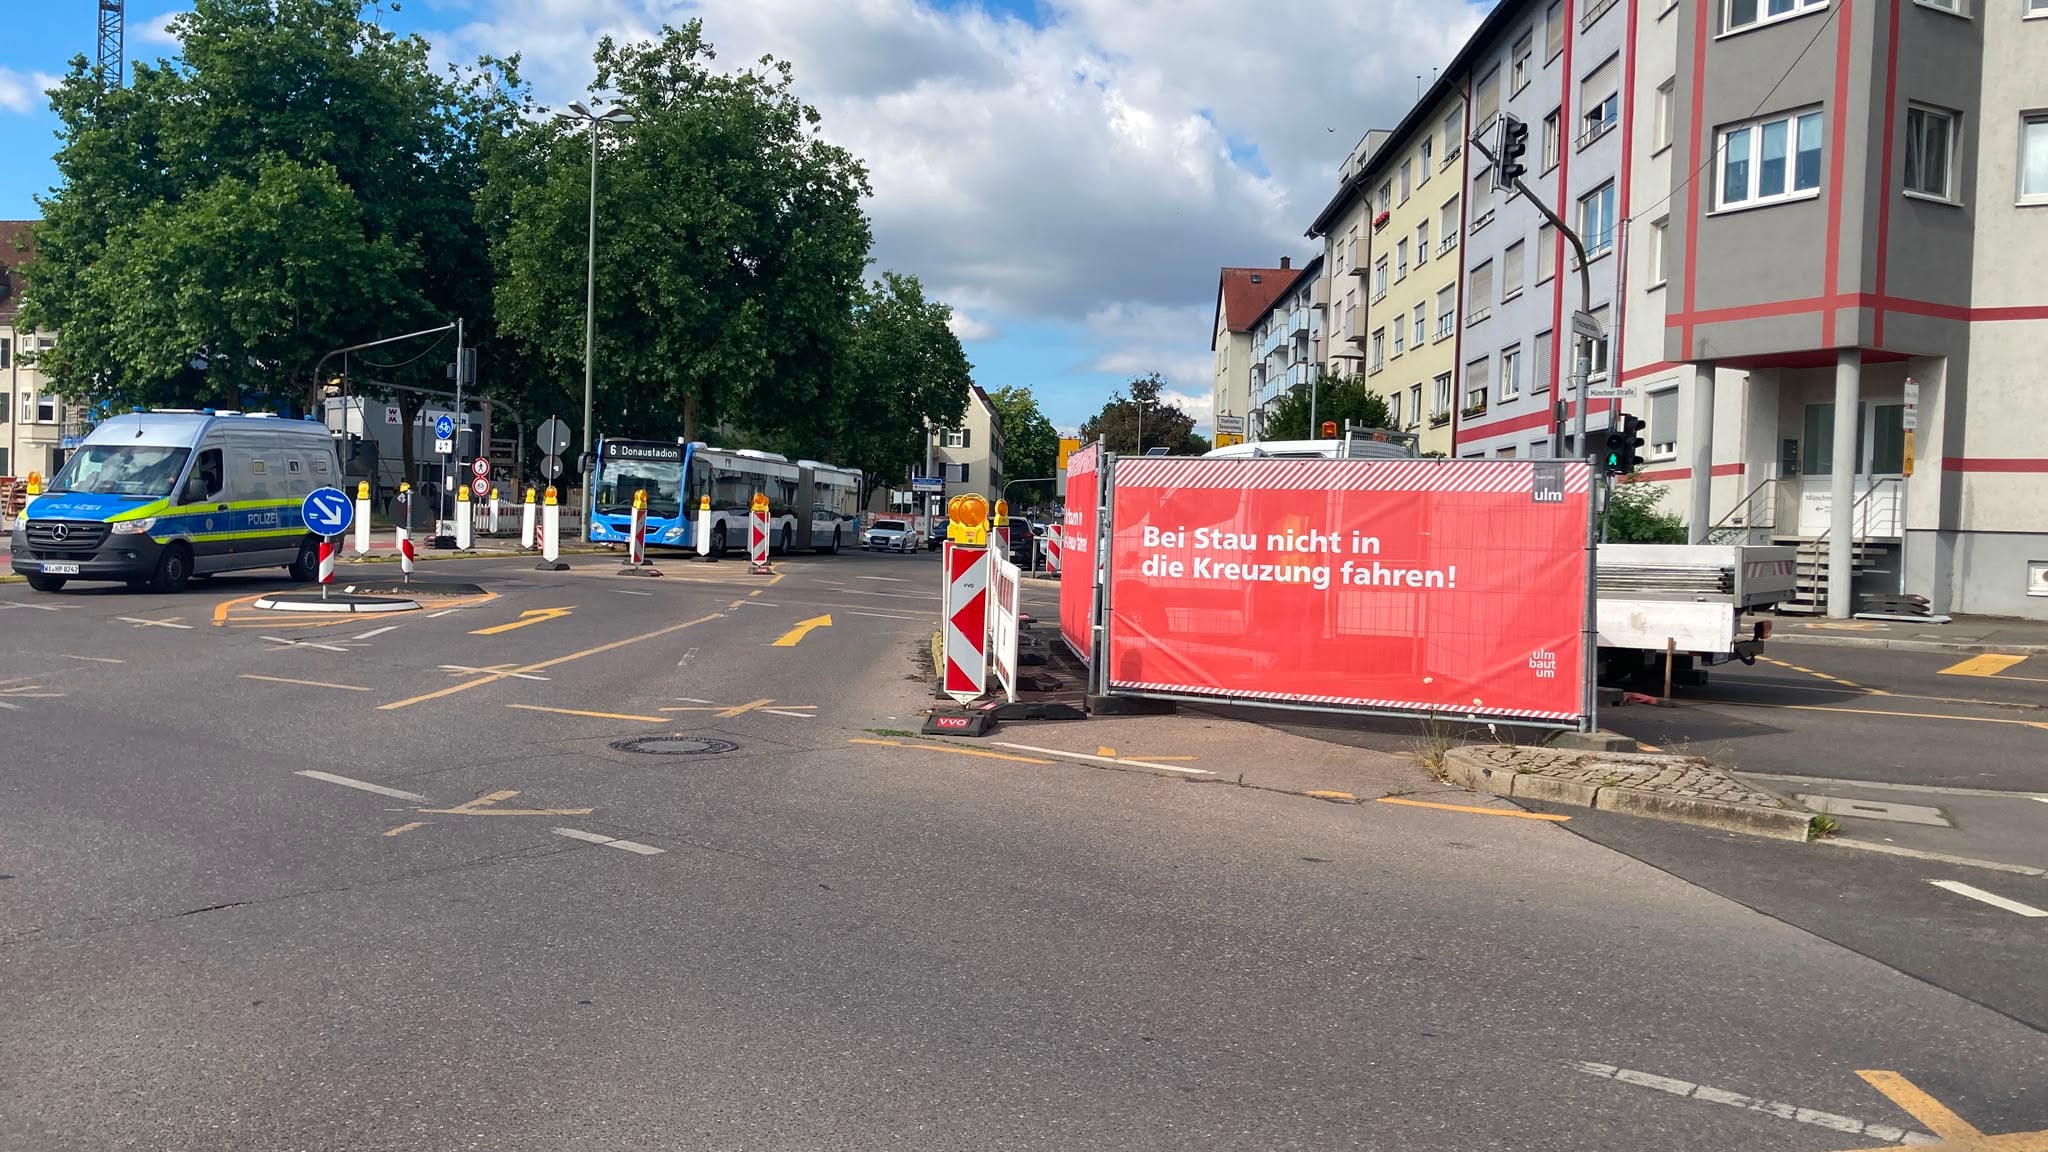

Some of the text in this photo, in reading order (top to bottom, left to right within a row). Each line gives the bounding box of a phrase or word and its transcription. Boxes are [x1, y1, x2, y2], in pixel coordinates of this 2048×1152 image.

[1617, 387, 1634, 396] Straße
[610, 445, 678, 458] 6 Donaustadion
[1534, 488, 1562, 501] ulm
[46, 503, 102, 511] POLIZEI
[247, 512, 279, 526] POLIZEI
[1143, 526, 1380, 554] Bei Stau nicht in
[1142, 554, 1457, 590] die Kreuzung fahren!
[1533, 648, 1555, 660] ulm
[1529, 657, 1556, 670] baut
[1536, 669, 1555, 679] um
[939, 717, 968, 727] VVO
